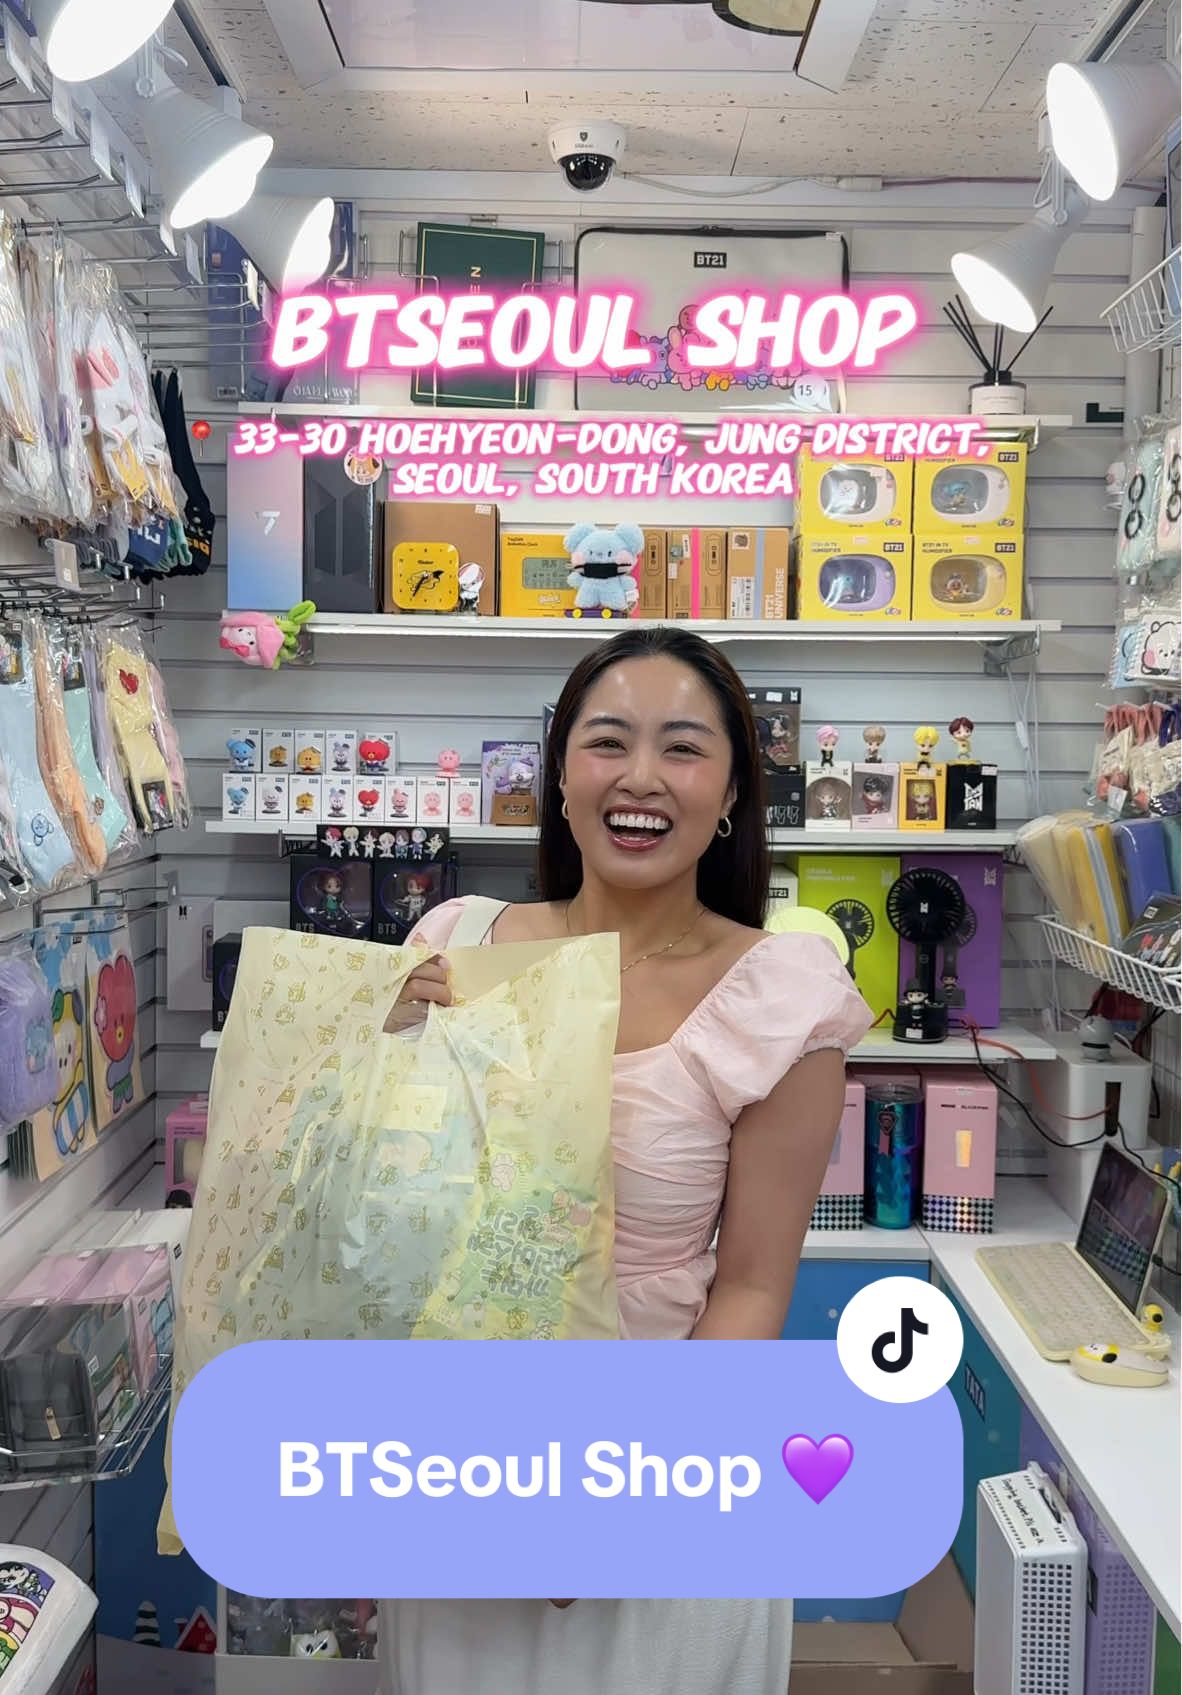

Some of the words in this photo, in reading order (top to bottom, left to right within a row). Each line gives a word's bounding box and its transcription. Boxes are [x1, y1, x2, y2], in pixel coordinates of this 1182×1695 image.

[696, 254, 725, 267] BT21
[798, 384, 813, 397] 15
[775, 567, 785, 619] UNIVERSE
[377, 923, 398, 935] BTS
